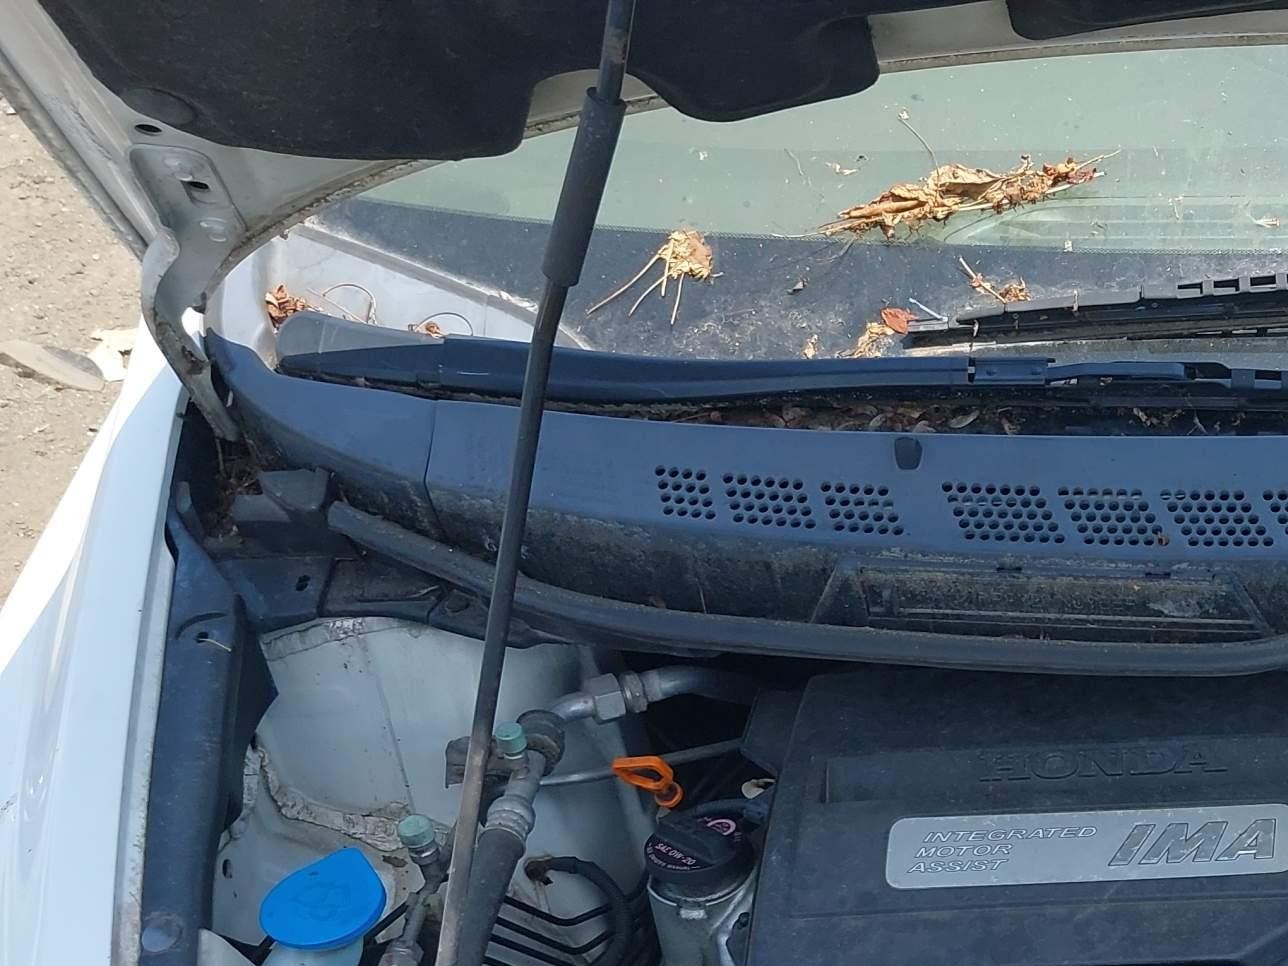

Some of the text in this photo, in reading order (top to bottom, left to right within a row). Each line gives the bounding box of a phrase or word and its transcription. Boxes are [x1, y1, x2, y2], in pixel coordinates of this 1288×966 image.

[978, 751, 1229, 783] HONDA
[923, 827, 1098, 843] INTEGRATED
[1108, 818, 1278, 867] IMA
[914, 844, 1013, 858] MOTOR
[907, 859, 1009, 873] ASSIST
